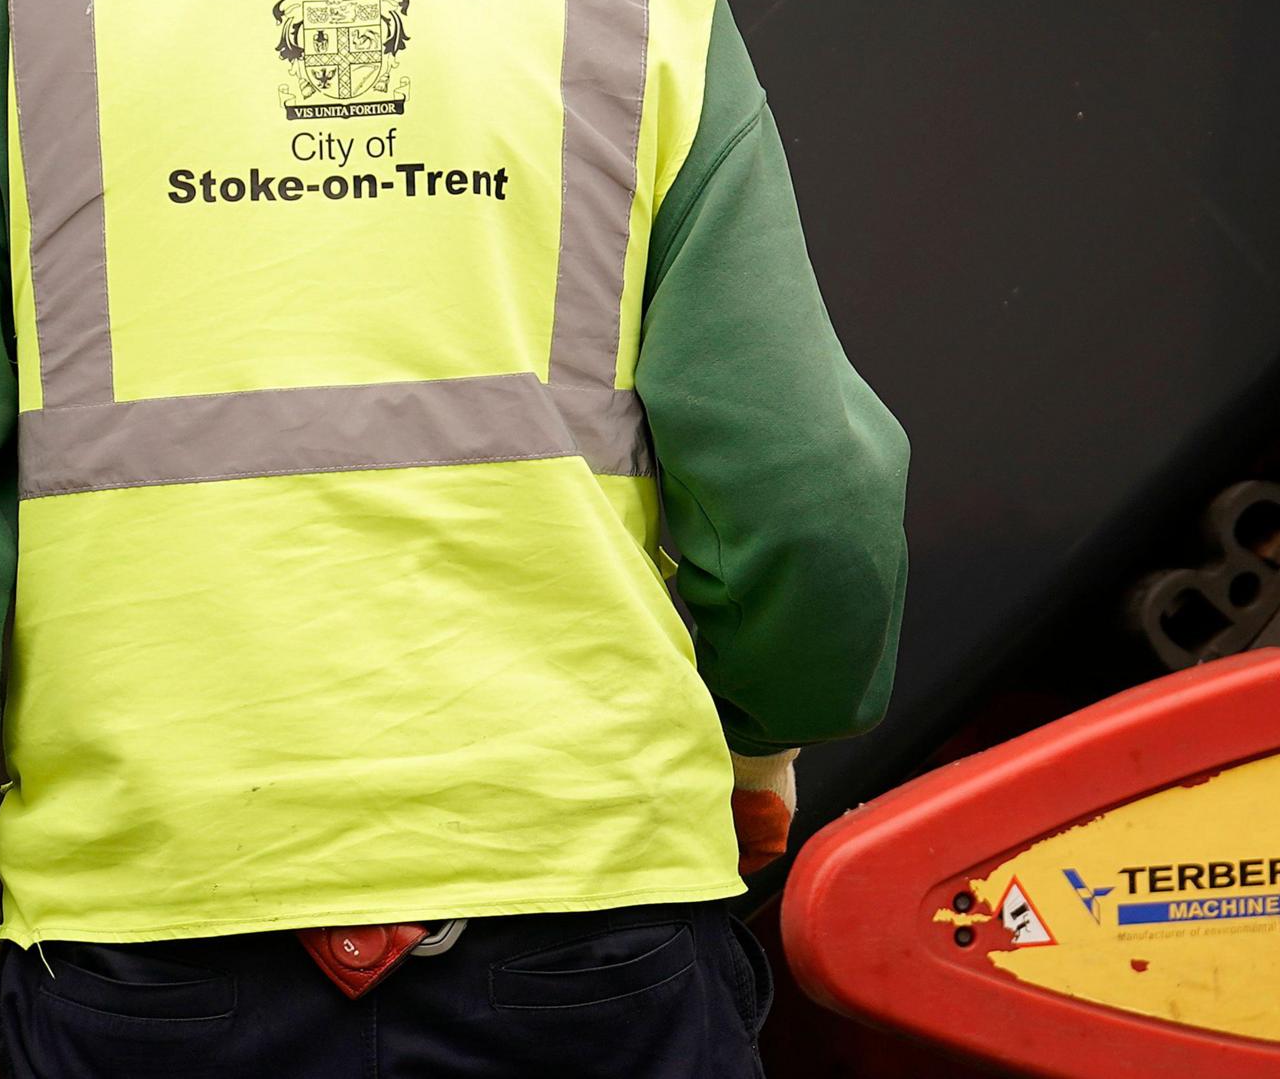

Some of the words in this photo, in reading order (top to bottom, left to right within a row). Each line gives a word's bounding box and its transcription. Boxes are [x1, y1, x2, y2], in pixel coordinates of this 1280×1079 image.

[295, 108, 313, 118] VIS
[315, 106, 348, 117] UNITA
[350, 103, 396, 115] FORTIOR
[291, 132, 354, 167] City
[366, 128, 396, 158] of
[168, 163, 508, 203] Stoke-on-Trent
[1190, 926, 1200, 938] of
